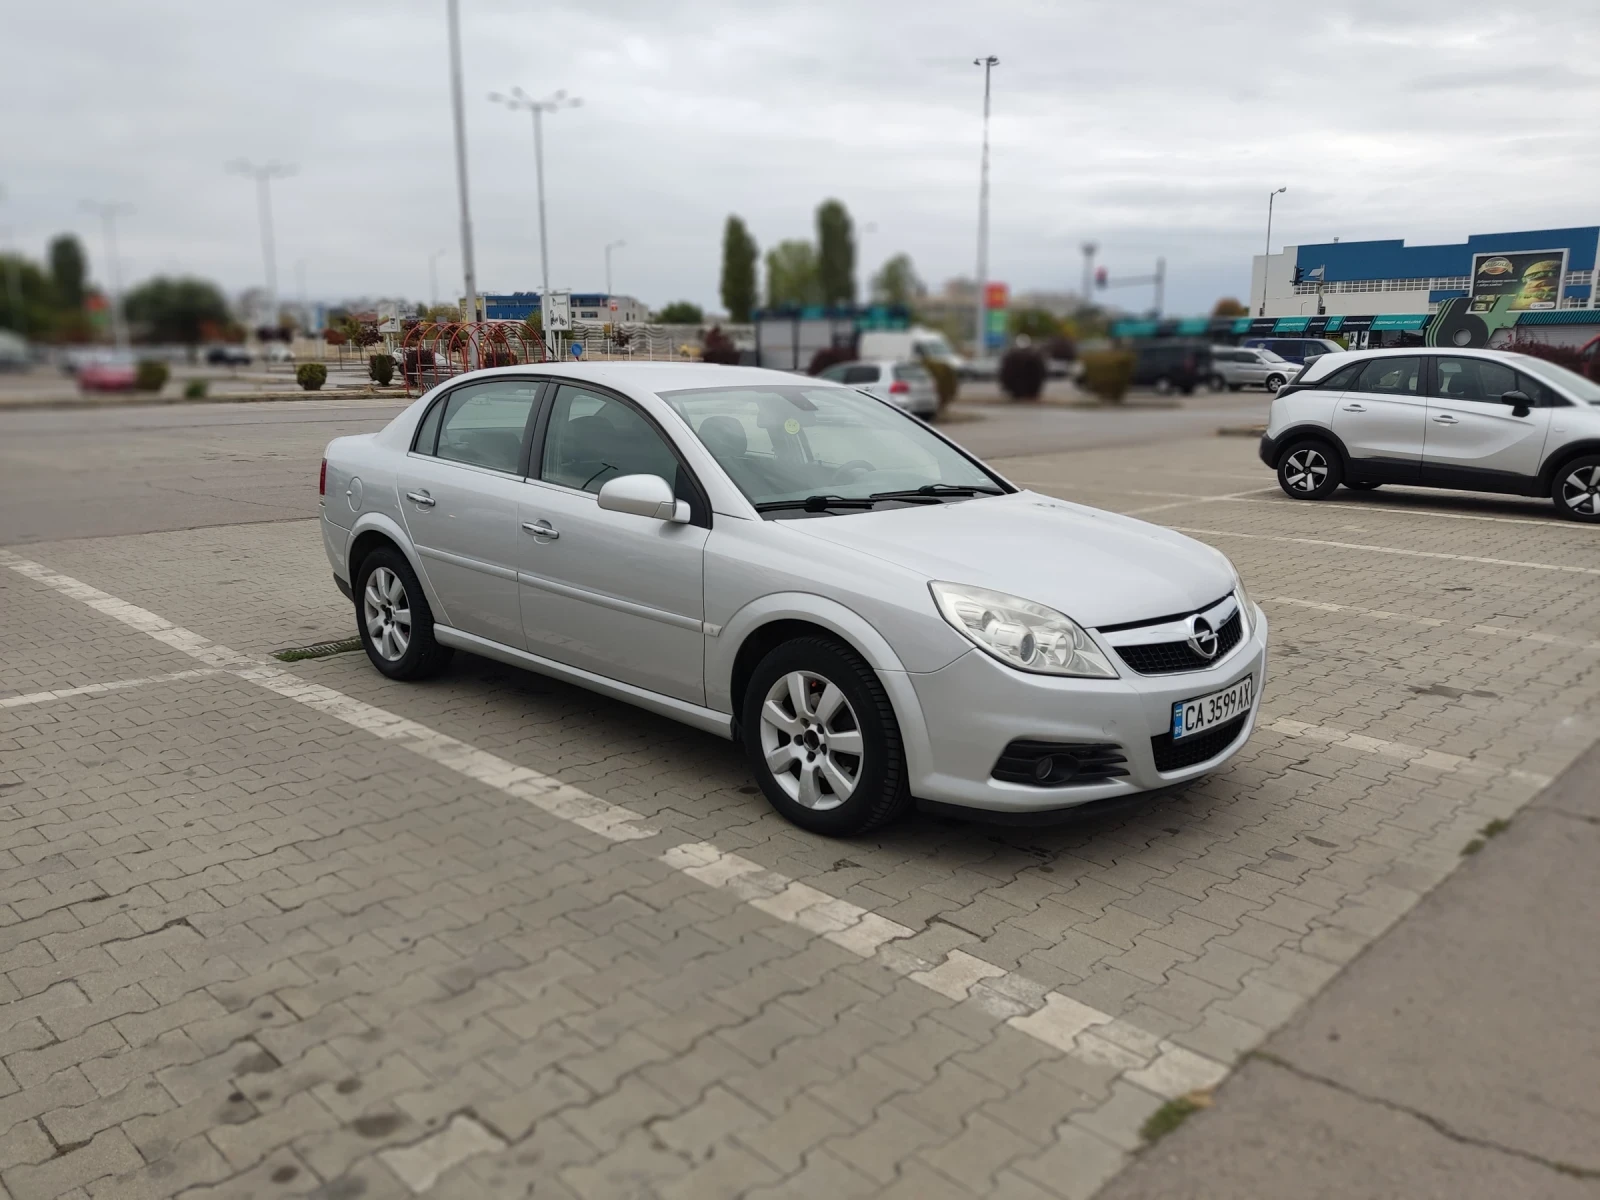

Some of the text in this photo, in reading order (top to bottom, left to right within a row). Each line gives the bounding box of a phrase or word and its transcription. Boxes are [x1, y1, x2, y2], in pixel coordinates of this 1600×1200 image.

[1185, 682, 1251, 732] CA 3599 AX
